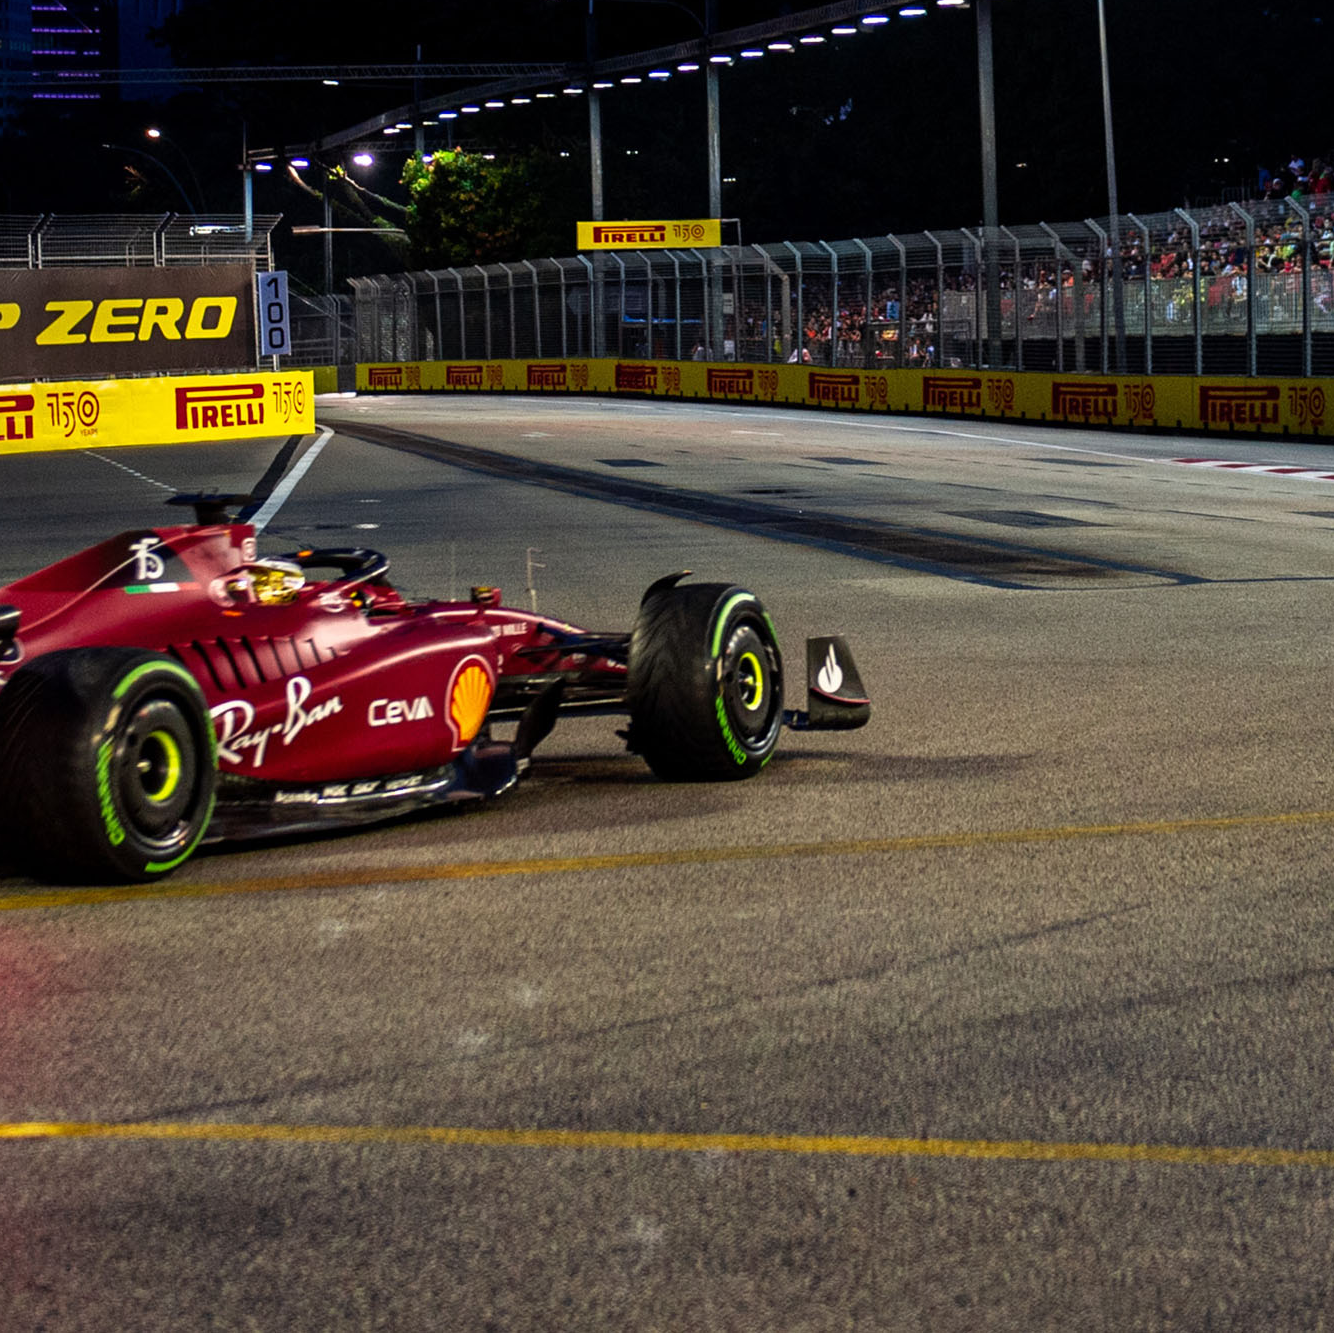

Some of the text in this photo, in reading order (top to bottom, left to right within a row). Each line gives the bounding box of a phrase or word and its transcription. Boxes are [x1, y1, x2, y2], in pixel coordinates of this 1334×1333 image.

[593, 224, 705, 243] PIRELLI 150
[35, 296, 238, 346] ZERO
[267, 277, 285, 350] 100
[446, 366, 483, 385] PIRELLI
[527, 364, 566, 385] PIRELLI
[707, 368, 753, 394] PIRELLI
[809, 372, 859, 402] PIRELLI
[175, 381, 306, 429] PIRELLI 150
[923, 377, 1015, 410] PIRELLI 150
[1052, 382, 1155, 418] PIRELLI 150
[1200, 385, 1325, 425] PIRELLI 150
[47, 391, 100, 438] 150
